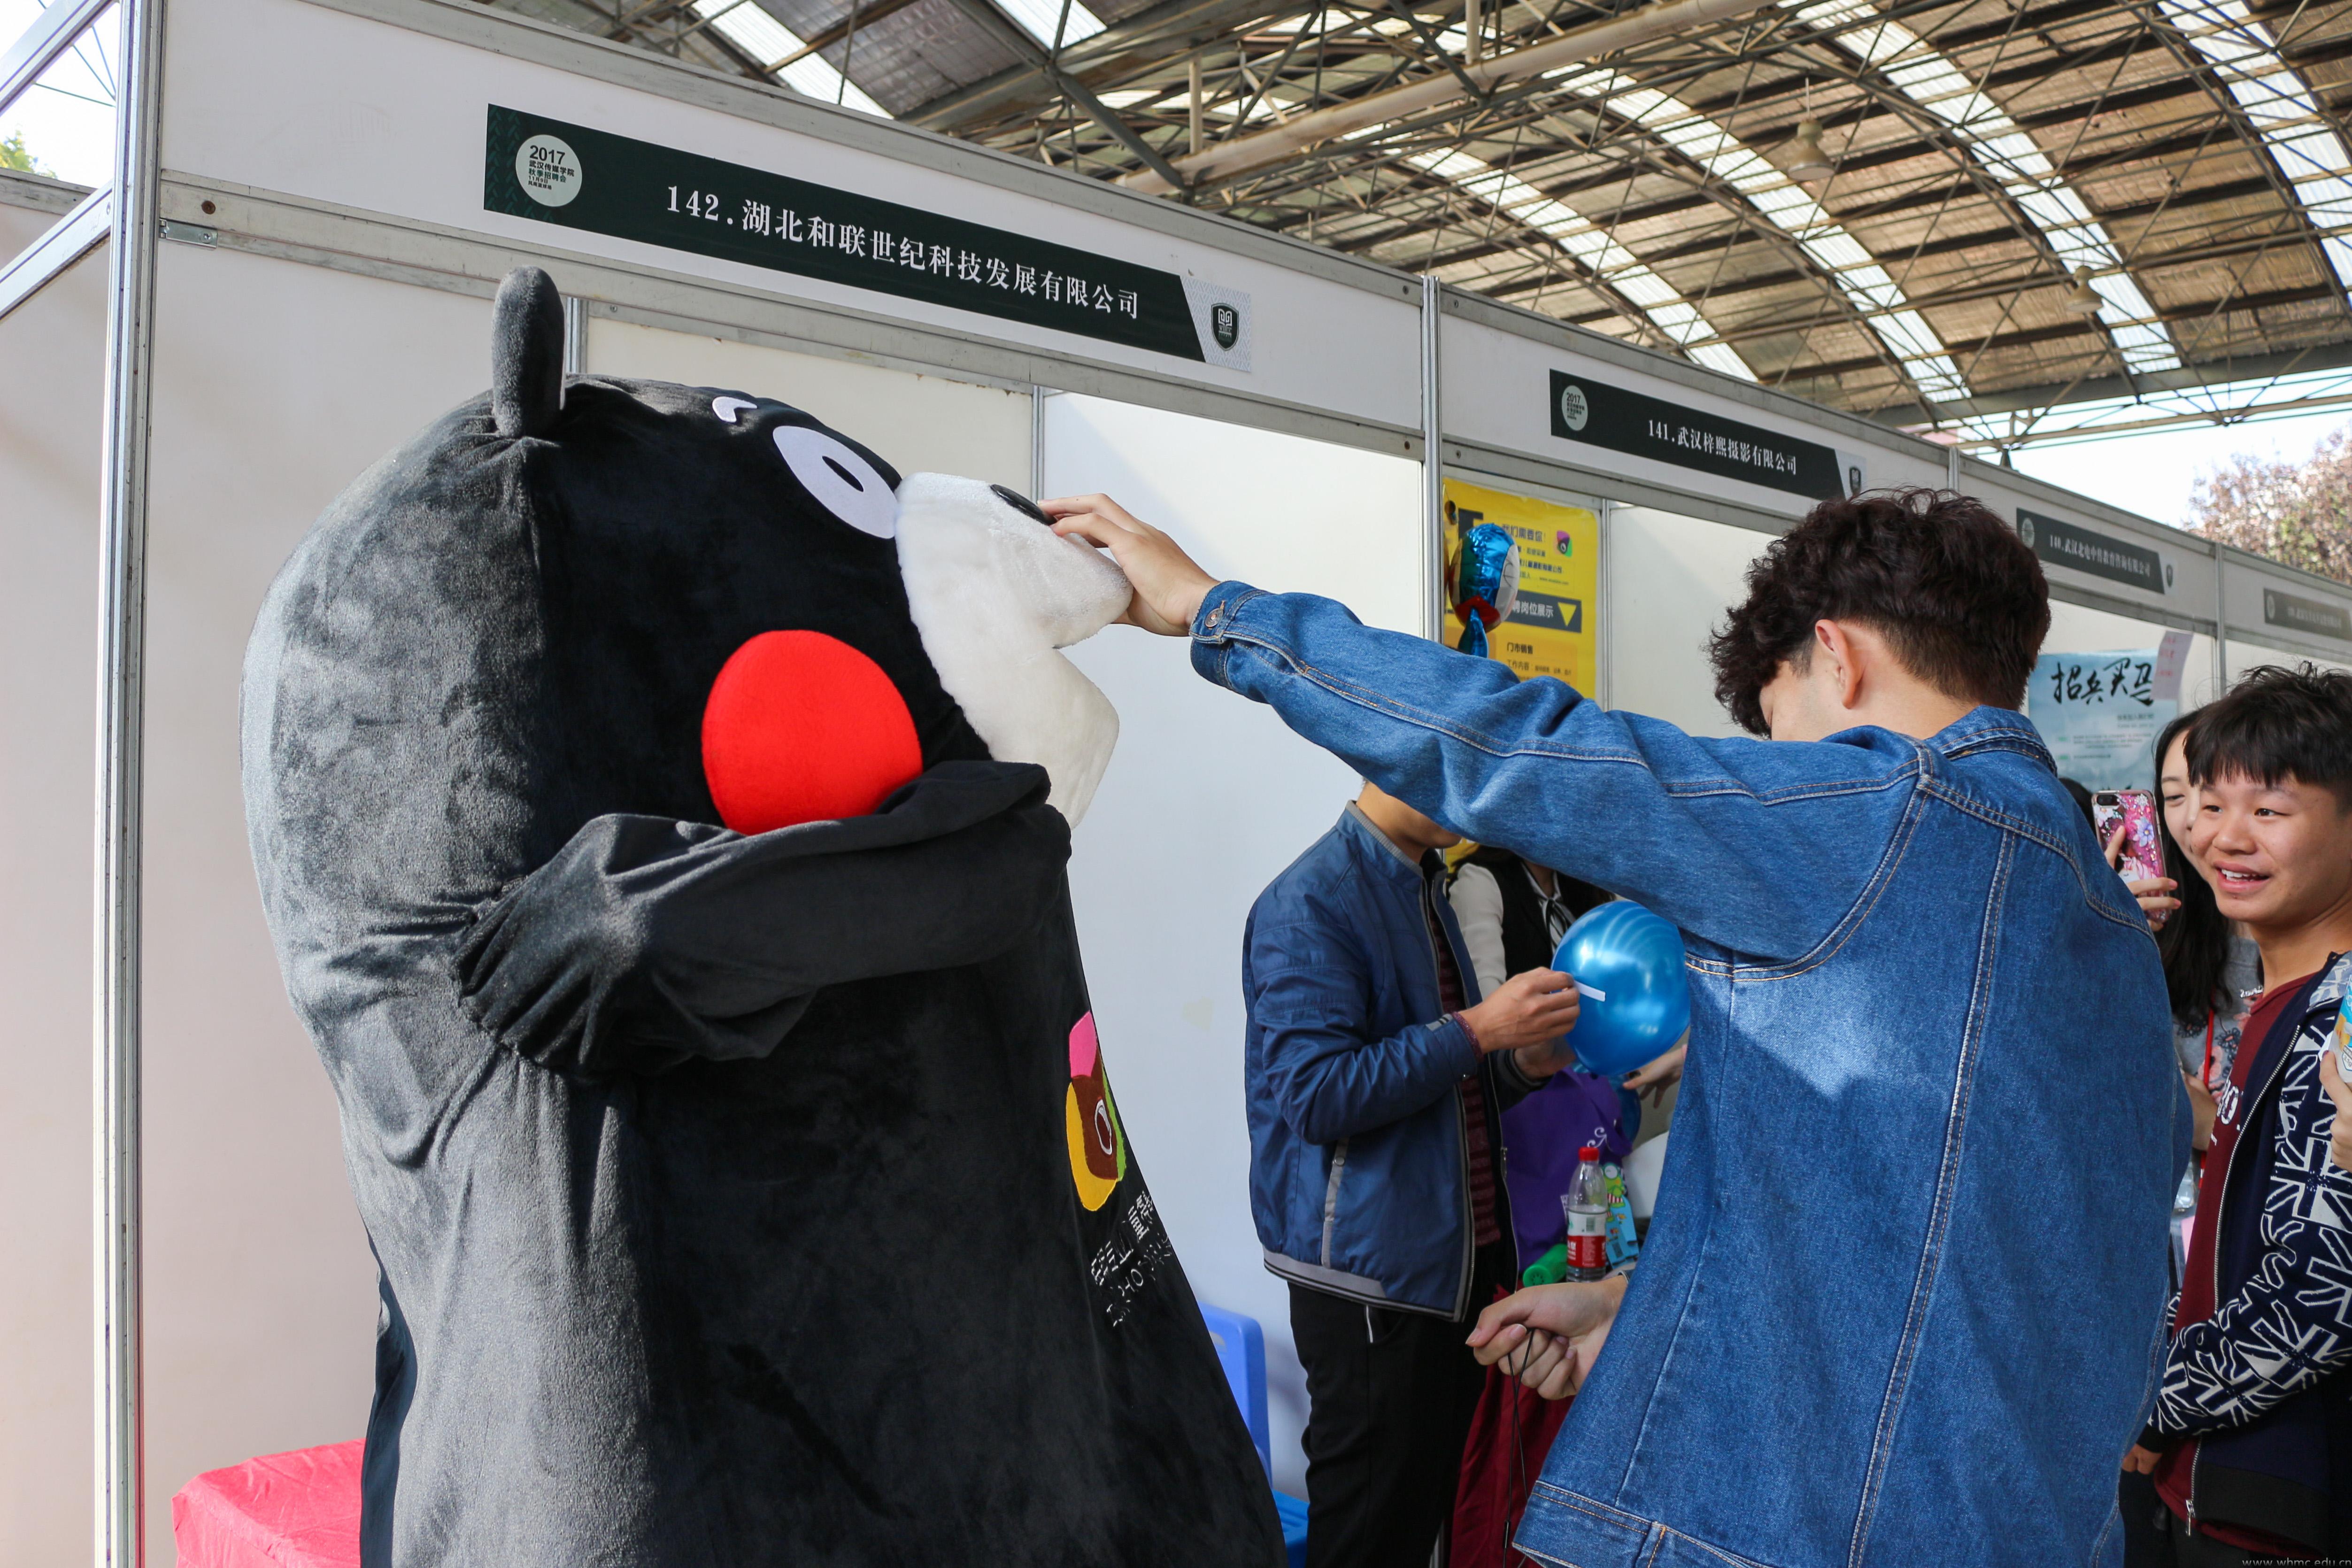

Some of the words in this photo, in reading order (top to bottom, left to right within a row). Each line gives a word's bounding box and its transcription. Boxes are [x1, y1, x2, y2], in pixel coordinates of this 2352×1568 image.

[530, 145, 565, 165] 2017
[529, 160, 575, 177] 武汉传媒学院
[529, 168, 567, 183] 秋季招聘会
[529, 176, 548, 184] 11月9日
[667, 185, 1139, 319] 142.湖北和联世纪科技发展有限公司
[1566, 392, 1581, 403] 2017
[1648, 419, 1797, 475] 141.武汉梓熙摄影有限公司
